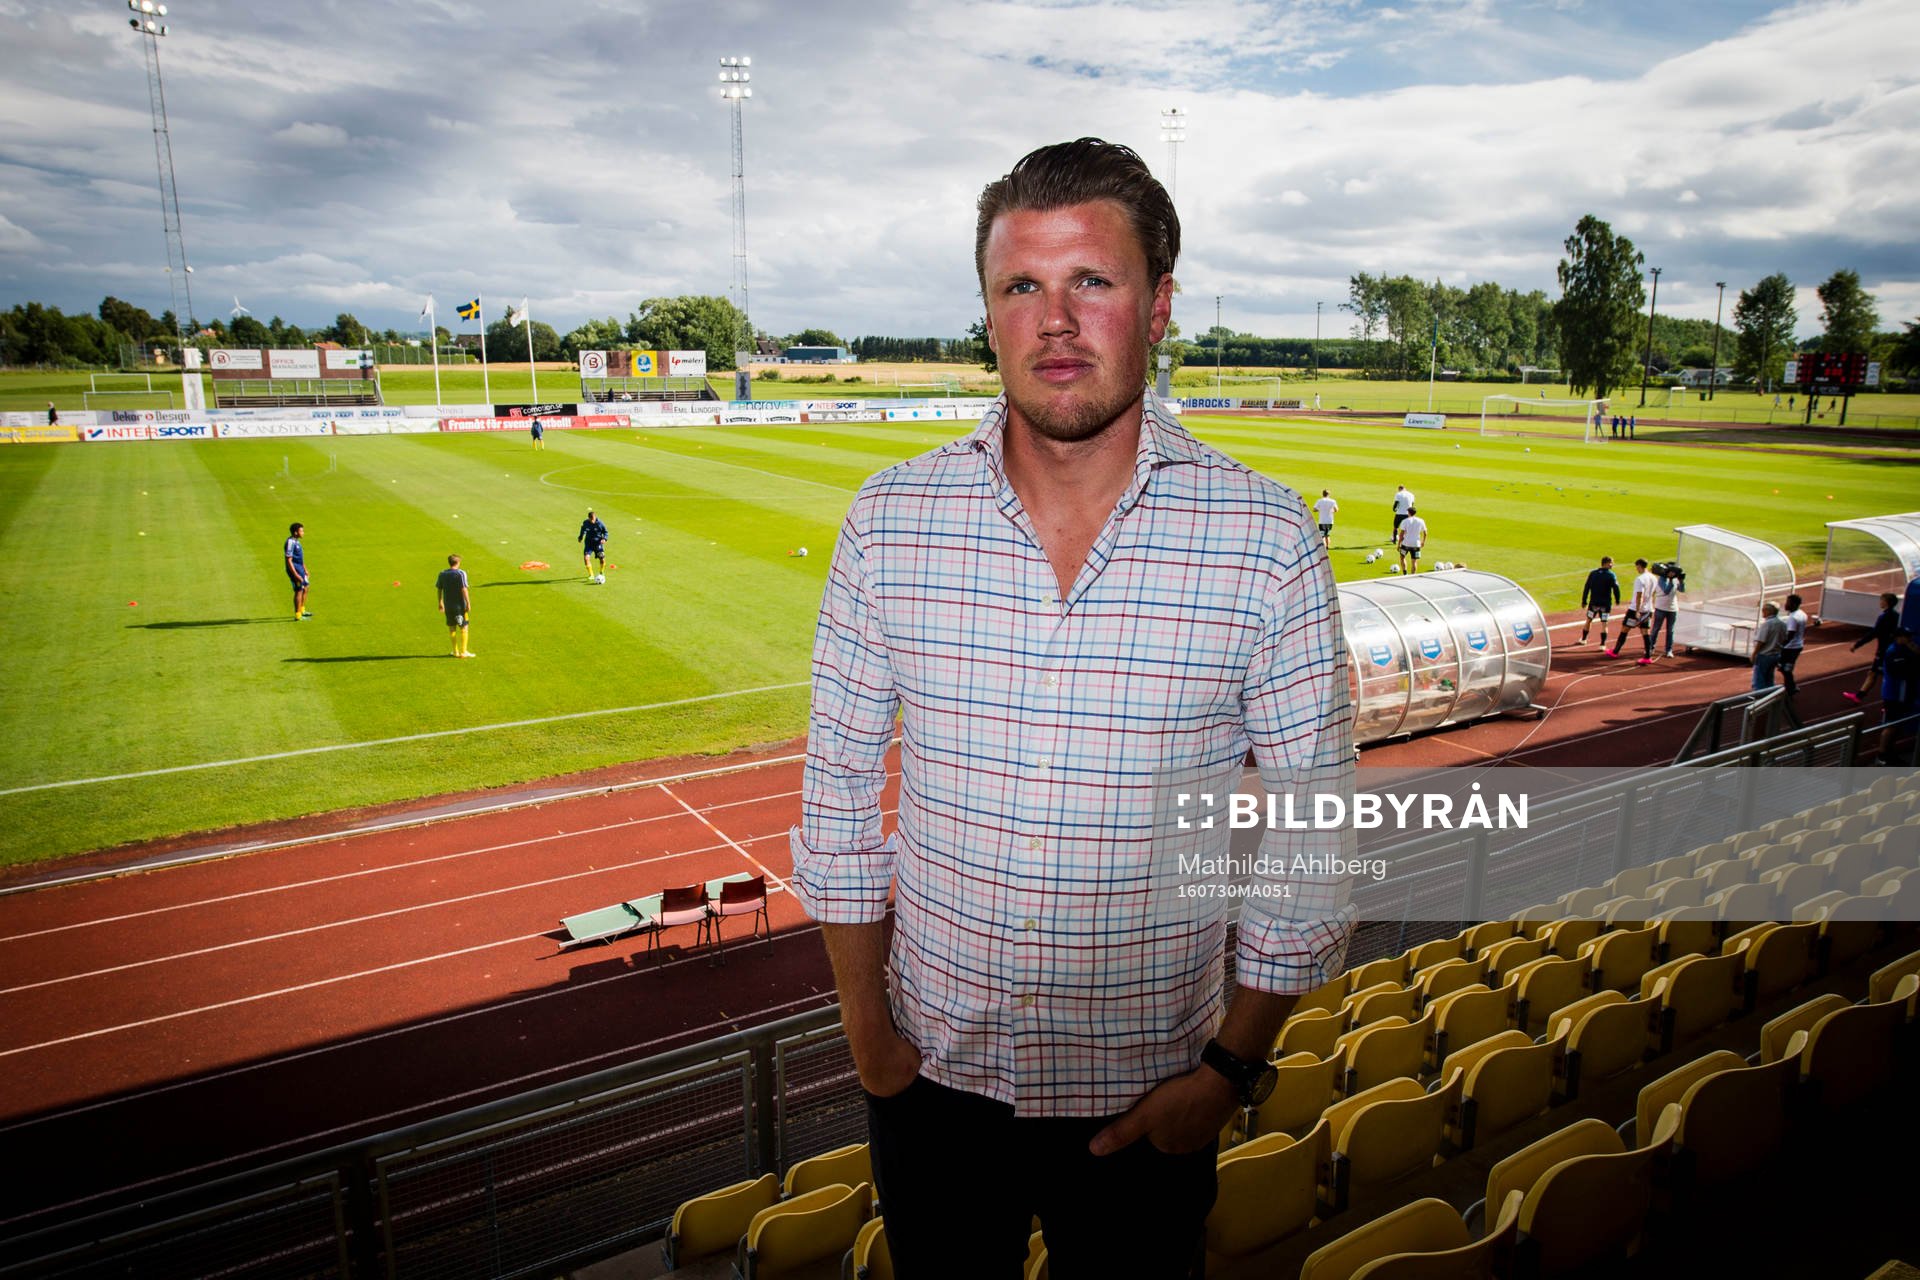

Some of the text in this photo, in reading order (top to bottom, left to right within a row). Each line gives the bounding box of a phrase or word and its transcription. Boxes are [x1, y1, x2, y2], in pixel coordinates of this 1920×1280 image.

[112, 411, 190, 423] Dekor Design
[448, 419, 485, 430] Framåt
[487, 418, 501, 430] för
[107, 426, 207, 438] INTERSPORT
